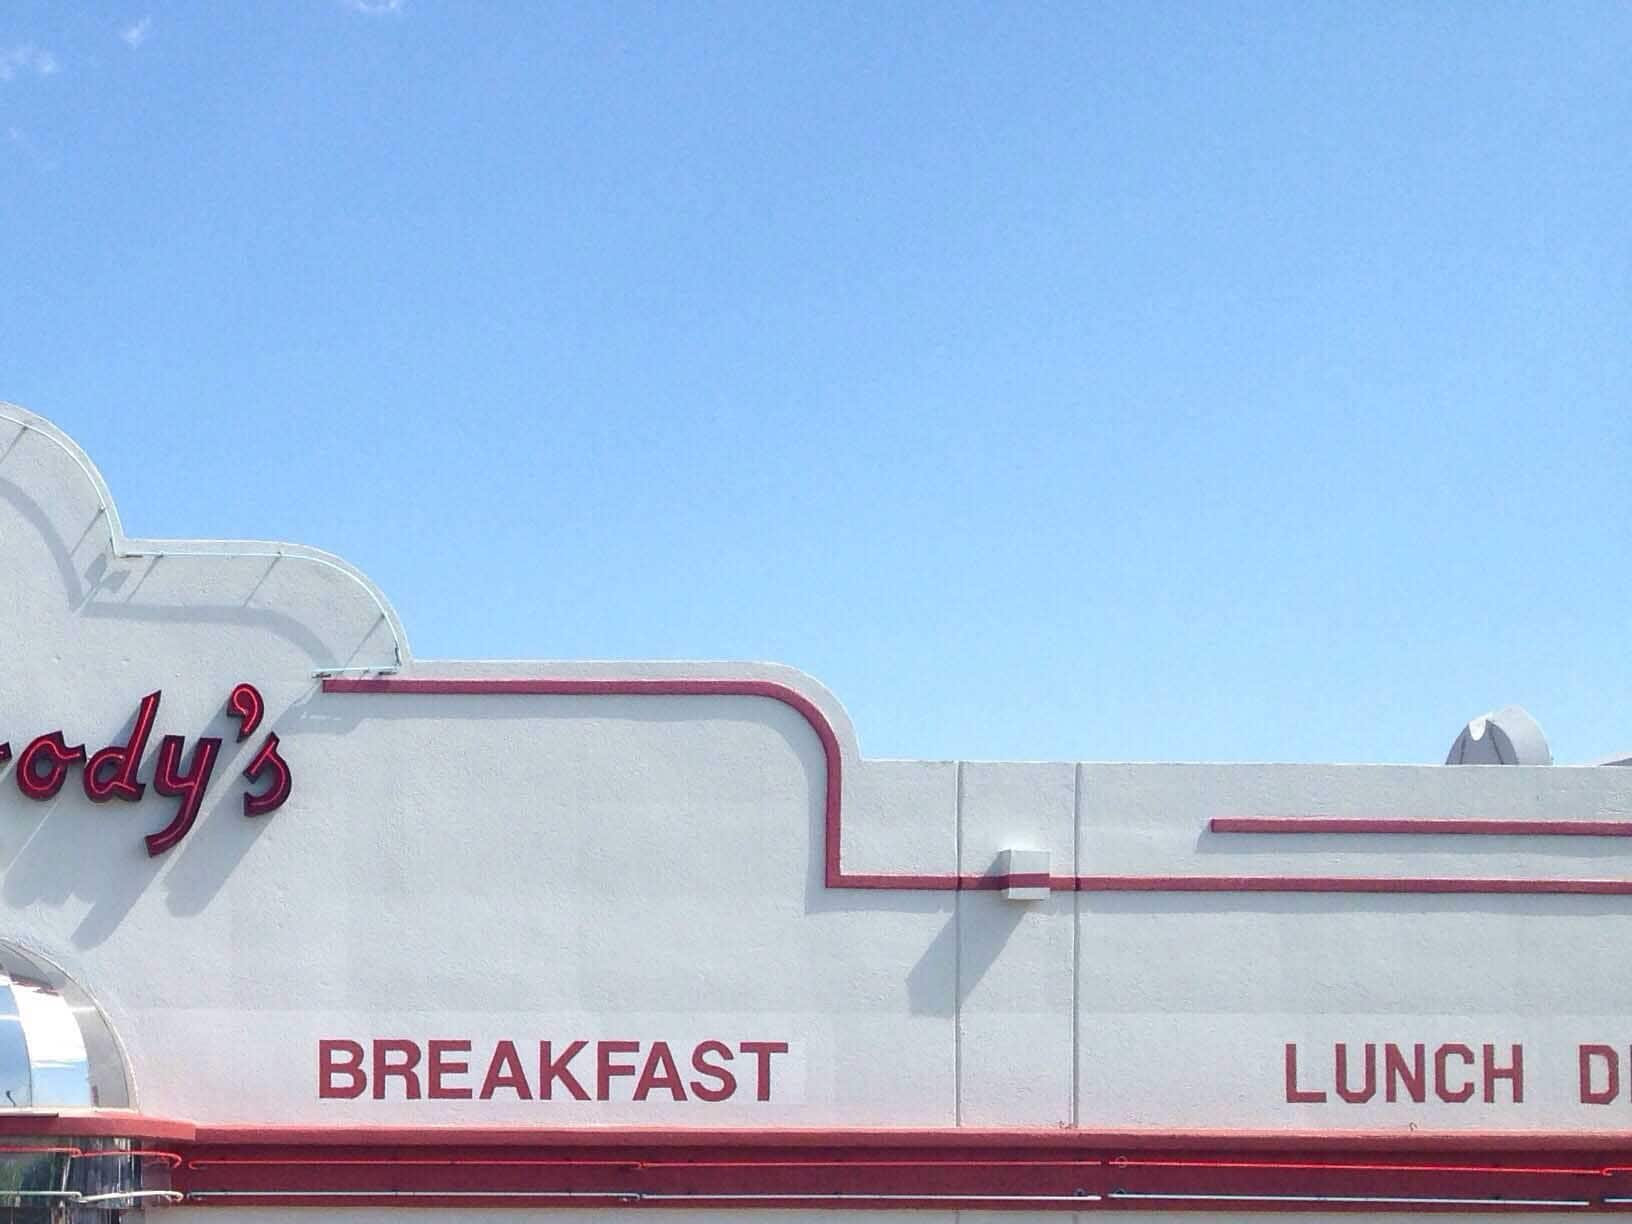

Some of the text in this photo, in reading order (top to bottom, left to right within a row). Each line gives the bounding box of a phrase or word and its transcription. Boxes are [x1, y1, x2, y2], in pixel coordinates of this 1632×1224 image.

[319, 1039, 785, 1101] BREAKFAST
[1285, 1043, 1632, 1104] LUNCH D
